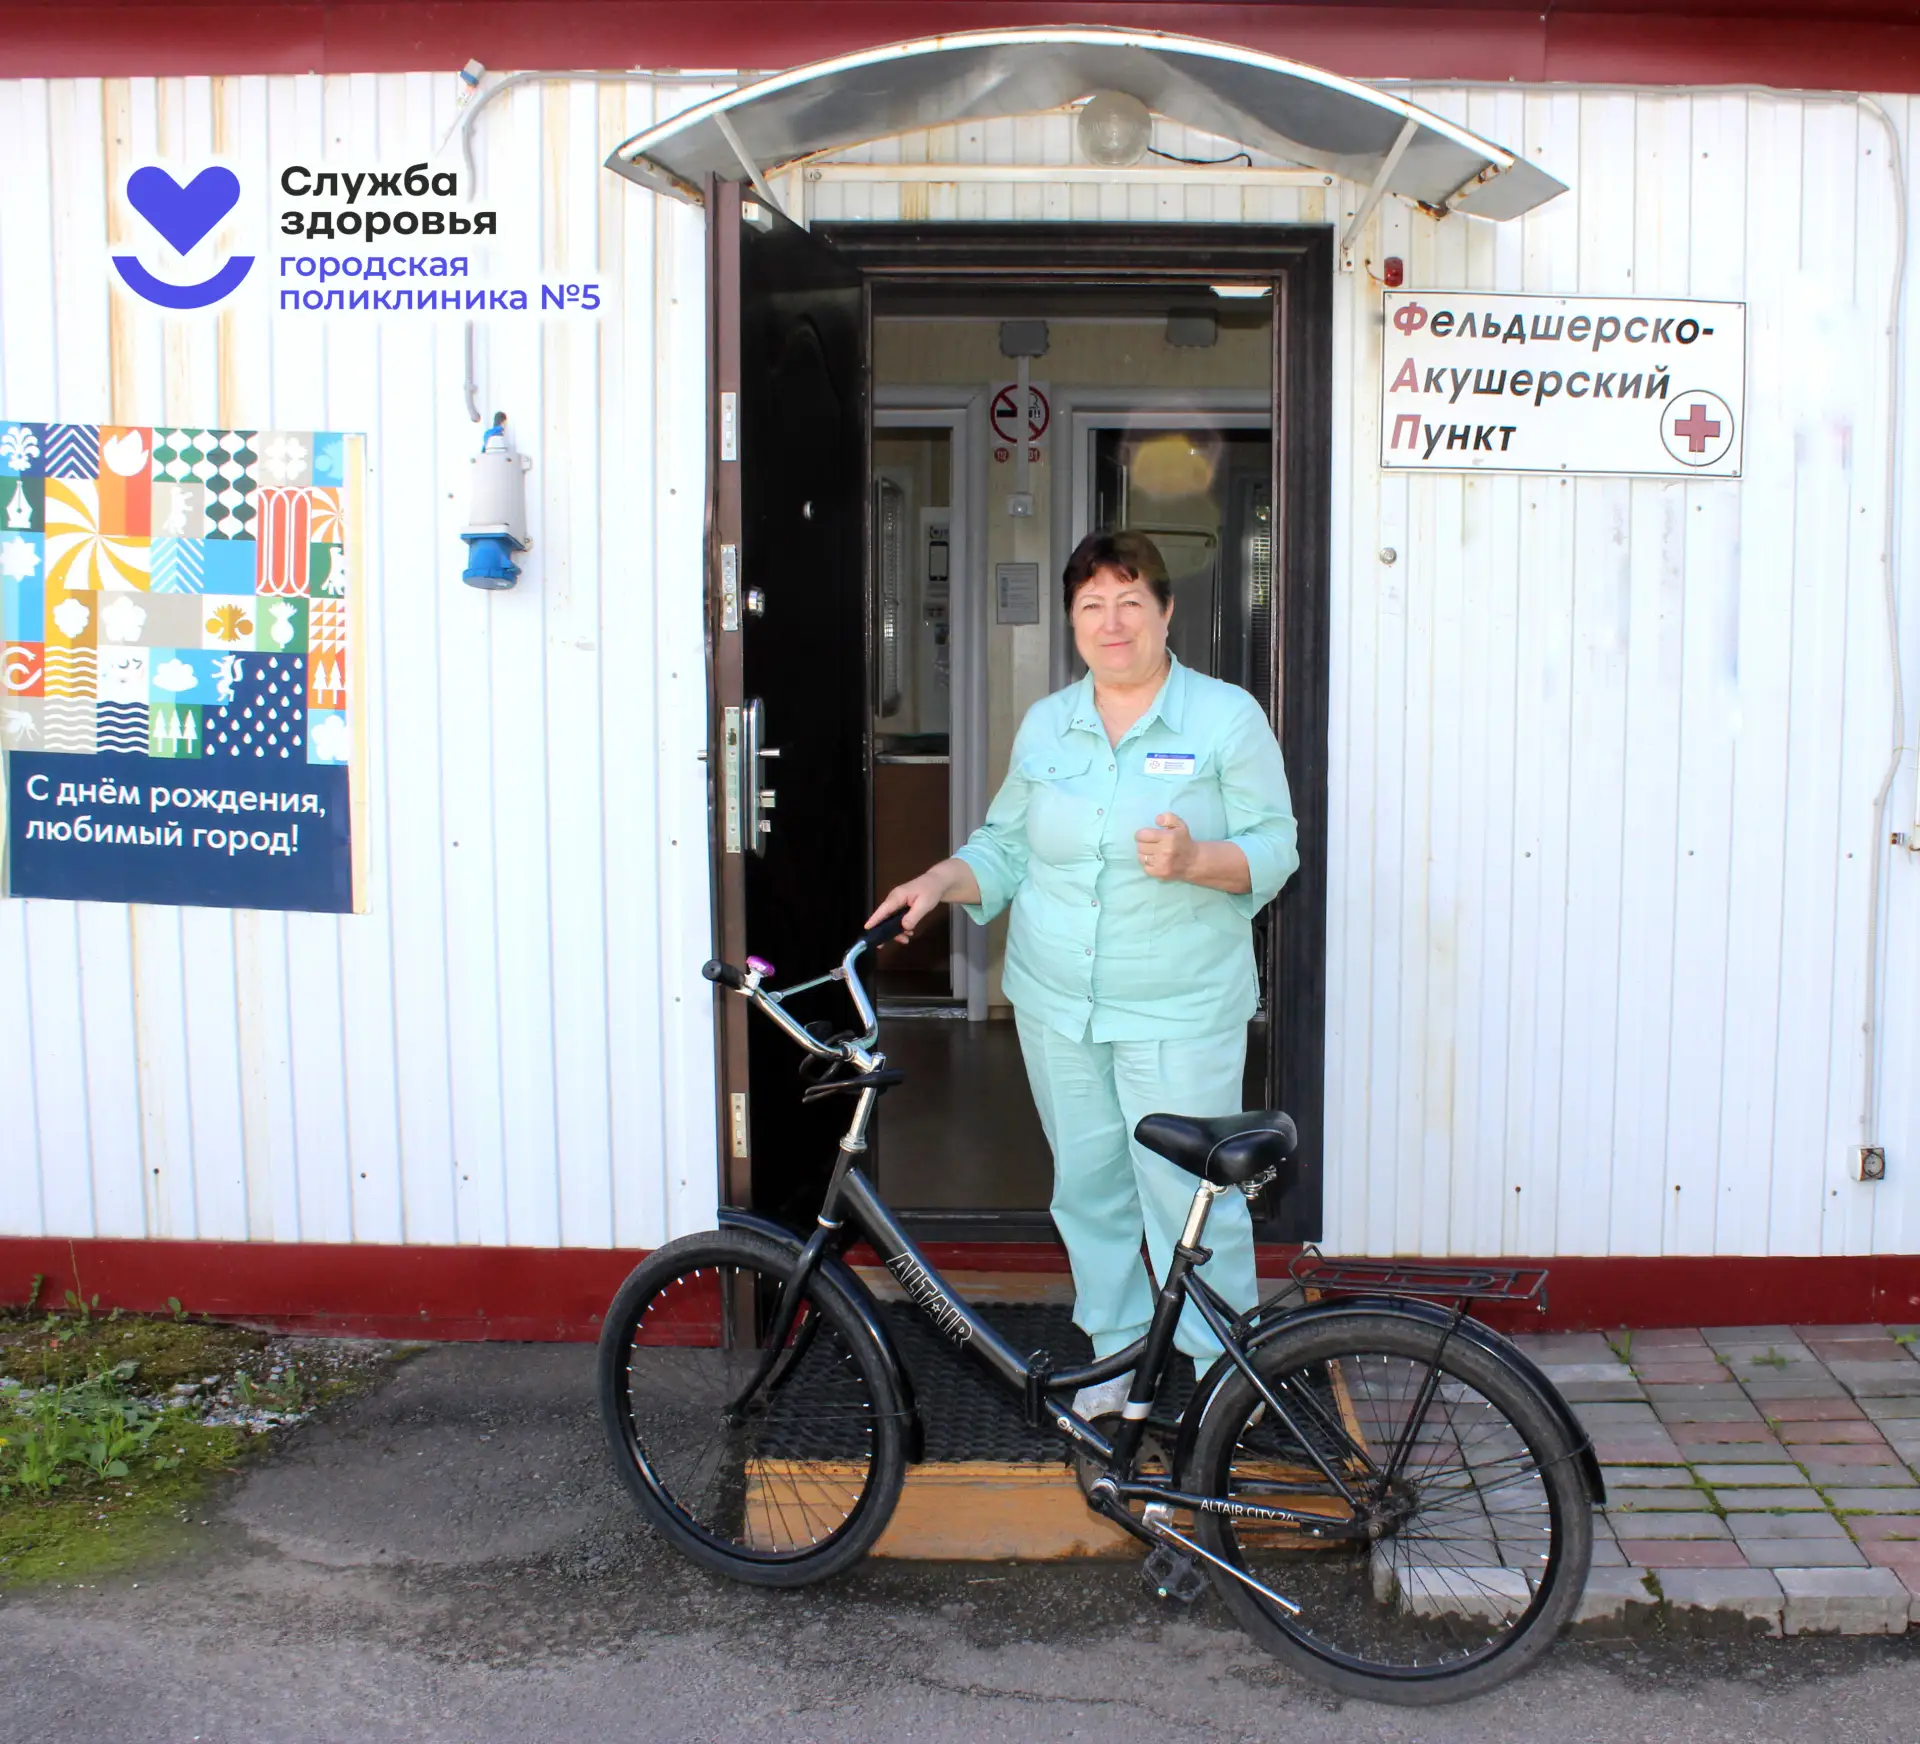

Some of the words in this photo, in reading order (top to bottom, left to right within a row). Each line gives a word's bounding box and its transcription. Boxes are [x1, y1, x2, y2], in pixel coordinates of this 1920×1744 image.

[1393, 302, 1714, 352] Фельдшерско-
[1389, 357, 1670, 407] Акушерский
[1390, 414, 1517, 460] Пункт
[26, 774, 49, 801] С
[57, 777, 140, 806] днём
[151, 786, 326, 817] рождения,
[26, 815, 182, 847] любимый
[193, 825, 299, 856] город!
[886, 1252, 973, 1349] ALTAIR
[1201, 1499, 1244, 1517] ALTAIR
[1246, 1507, 1276, 1520] CITY
